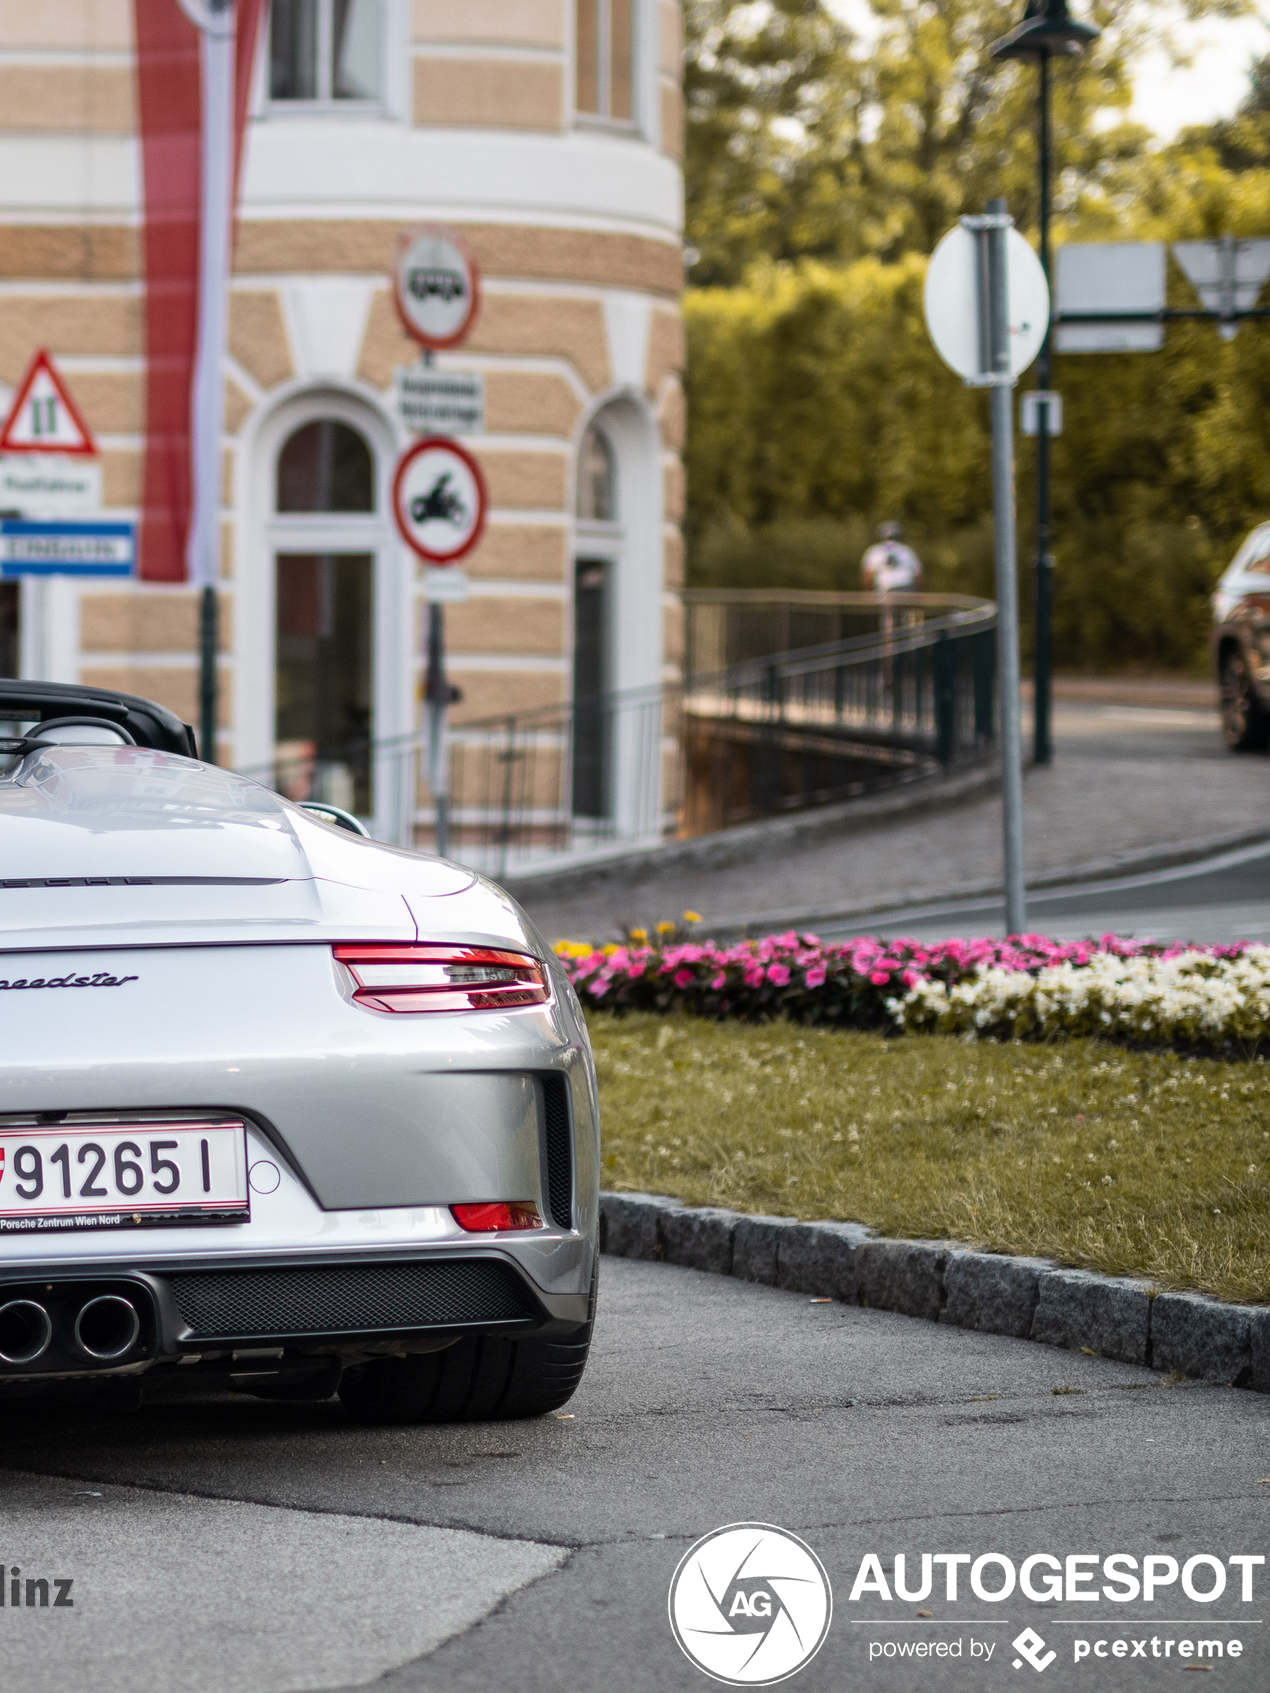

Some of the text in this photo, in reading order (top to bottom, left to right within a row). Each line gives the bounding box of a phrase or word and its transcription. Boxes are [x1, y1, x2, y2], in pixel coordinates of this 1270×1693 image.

[13, 1140, 180, 1199] 91265
[0, 1215, 120, 1230] Porsche Zentrum Wien Nord
